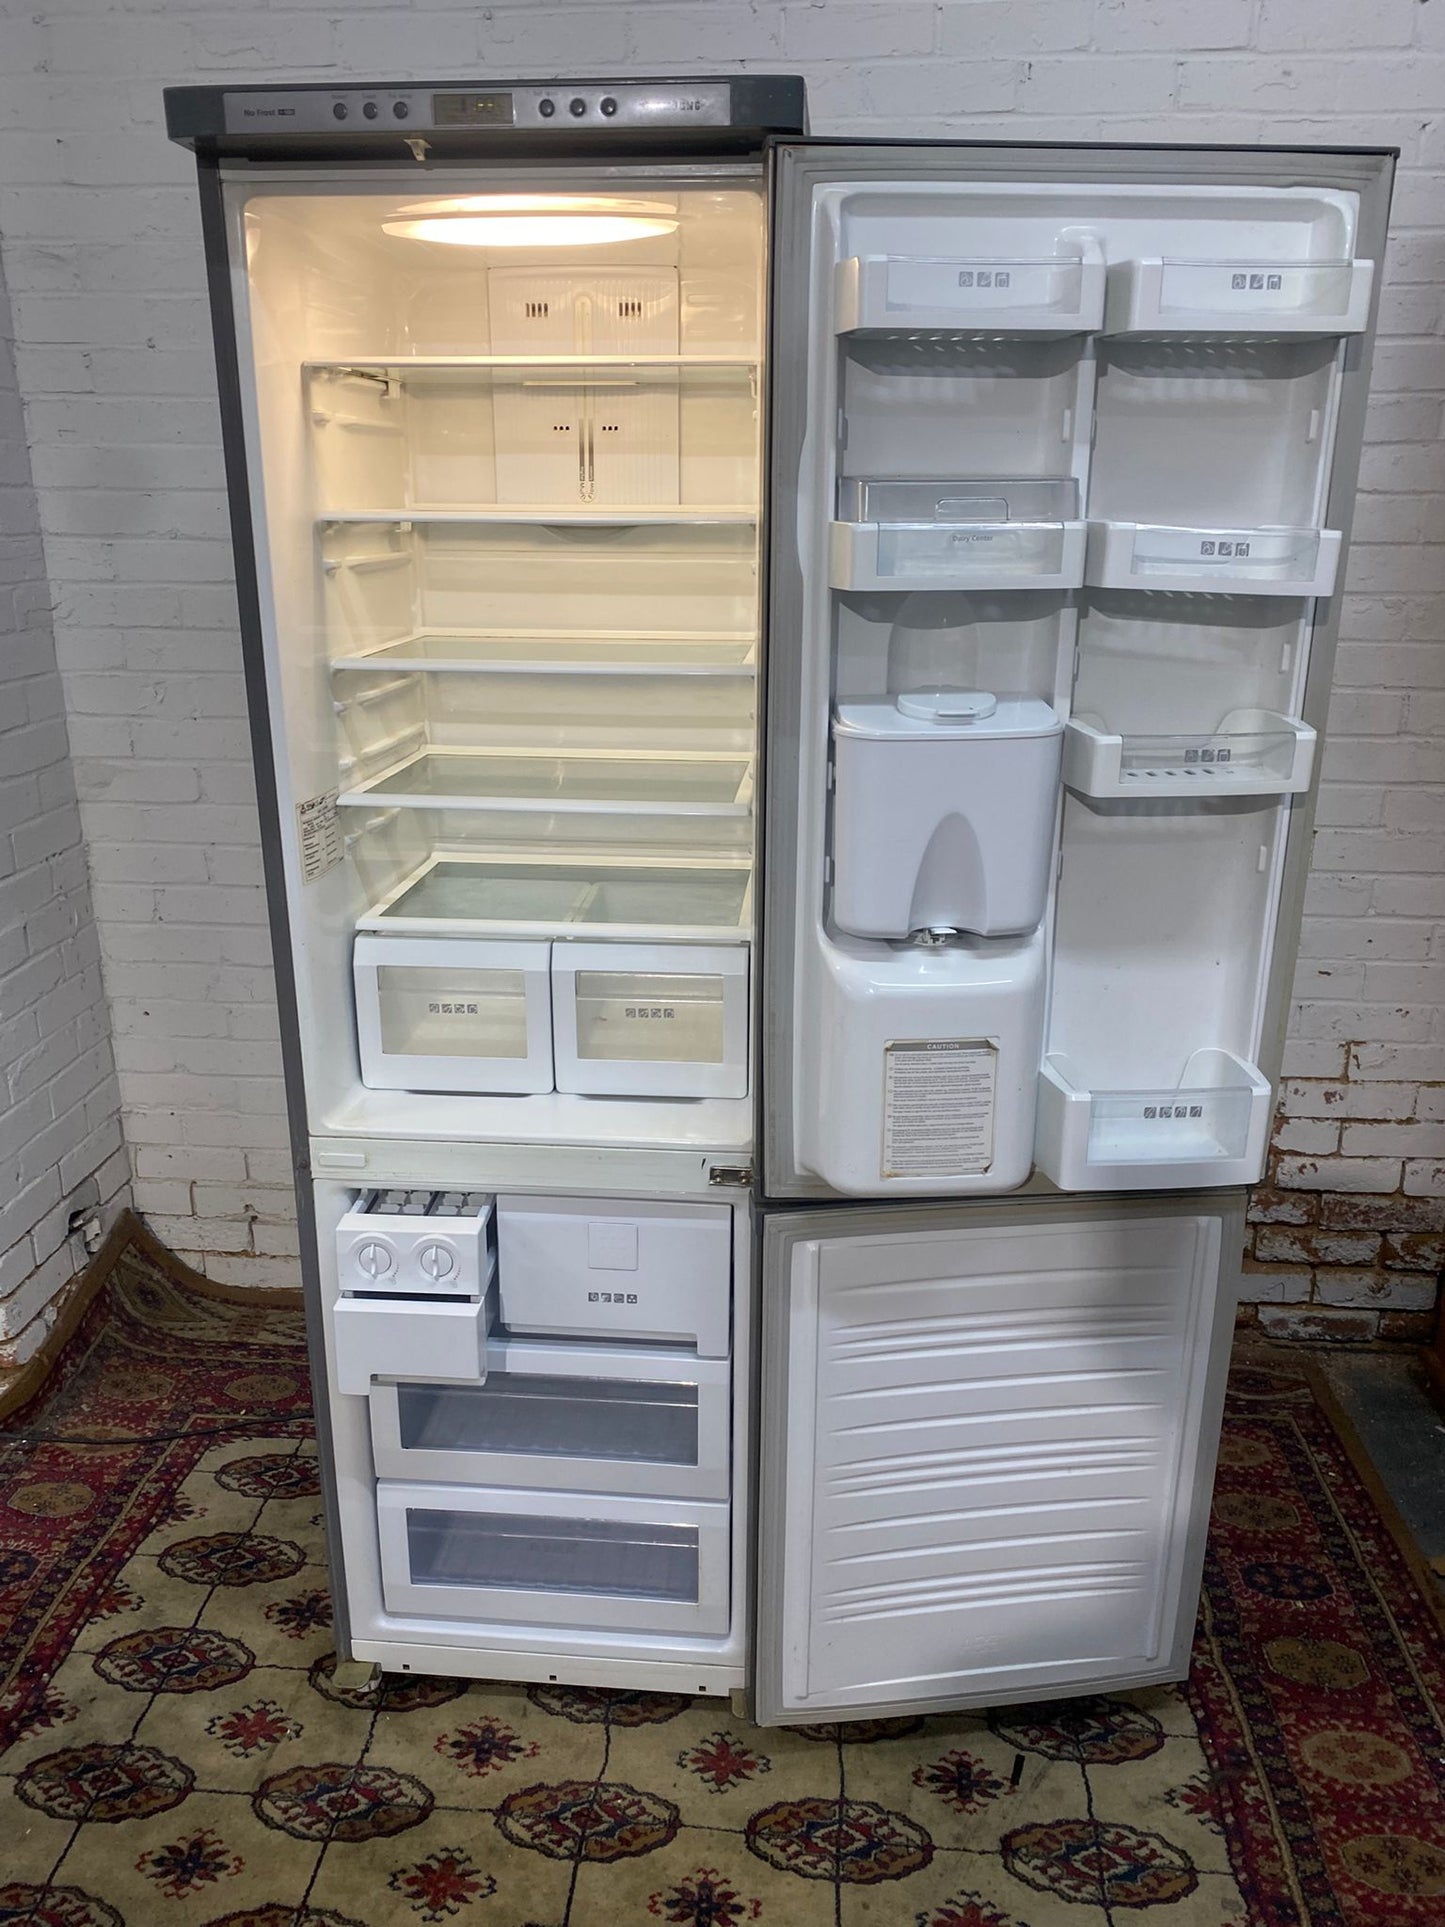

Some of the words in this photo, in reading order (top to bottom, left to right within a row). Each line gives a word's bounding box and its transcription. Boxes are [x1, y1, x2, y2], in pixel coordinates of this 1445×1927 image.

[244, 109, 255, 117] No
[257, 108, 276, 116] Frost
[952, 535, 970, 543] Dairy
[972, 534, 993, 542] Center
